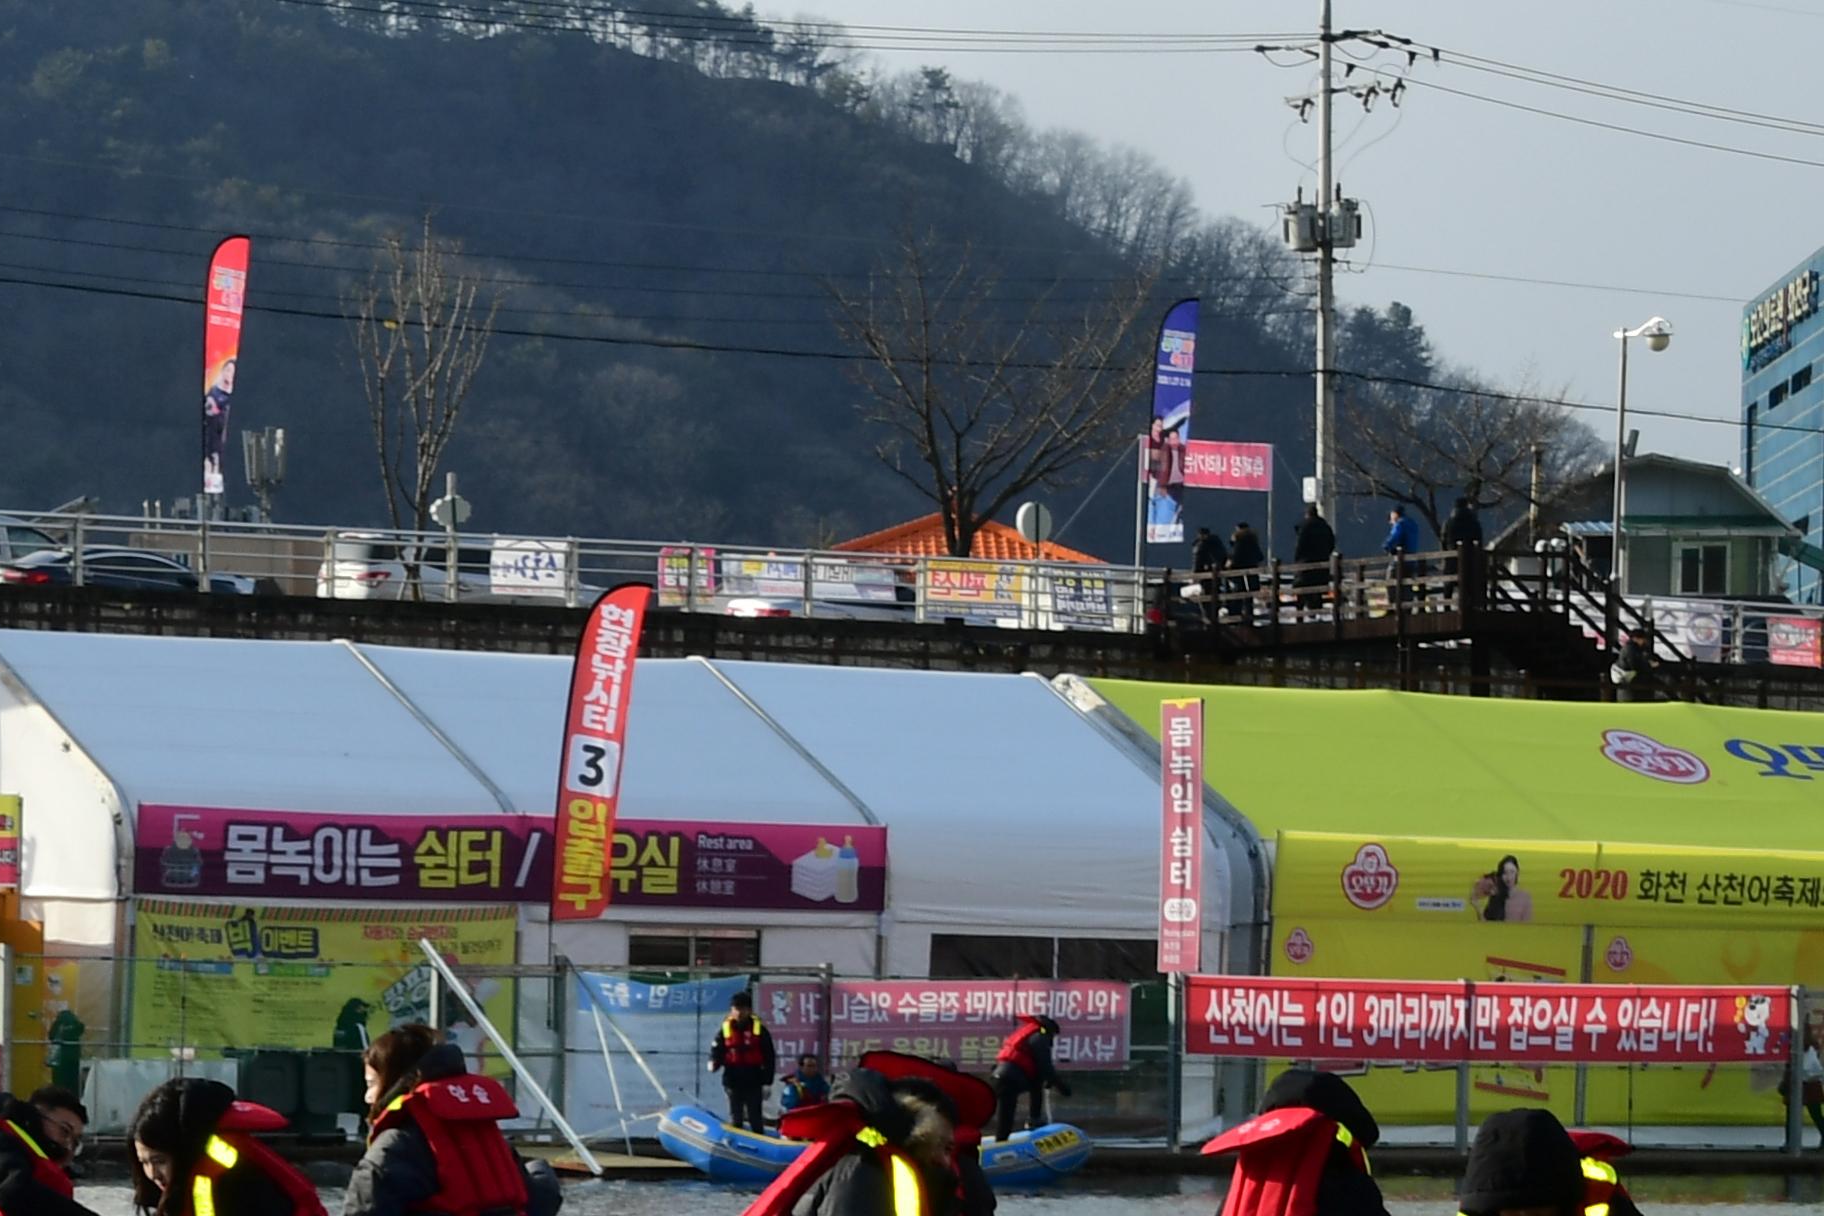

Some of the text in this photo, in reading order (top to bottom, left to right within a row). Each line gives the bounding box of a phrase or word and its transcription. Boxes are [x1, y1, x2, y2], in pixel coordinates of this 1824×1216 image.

[582, 603, 636, 734] 현장낚시터
[578, 744, 606, 787] 3
[1169, 716, 1195, 890] 몸녹임 쉼터
[223, 822, 403, 889] 몸녹이는
[413, 828, 502, 889] 쉼터
[611, 834, 681, 894] 유실
[557, 798, 609, 911] 입출구
[697, 834, 754, 851] Rest area
[1558, 868, 1824, 909] 2020 화천 산천어축제
[261, 926, 318, 957] 이벤트
[1204, 987, 1718, 1054] 산천어는 1인 3마리까지만 잡으실 수 있습니다!
